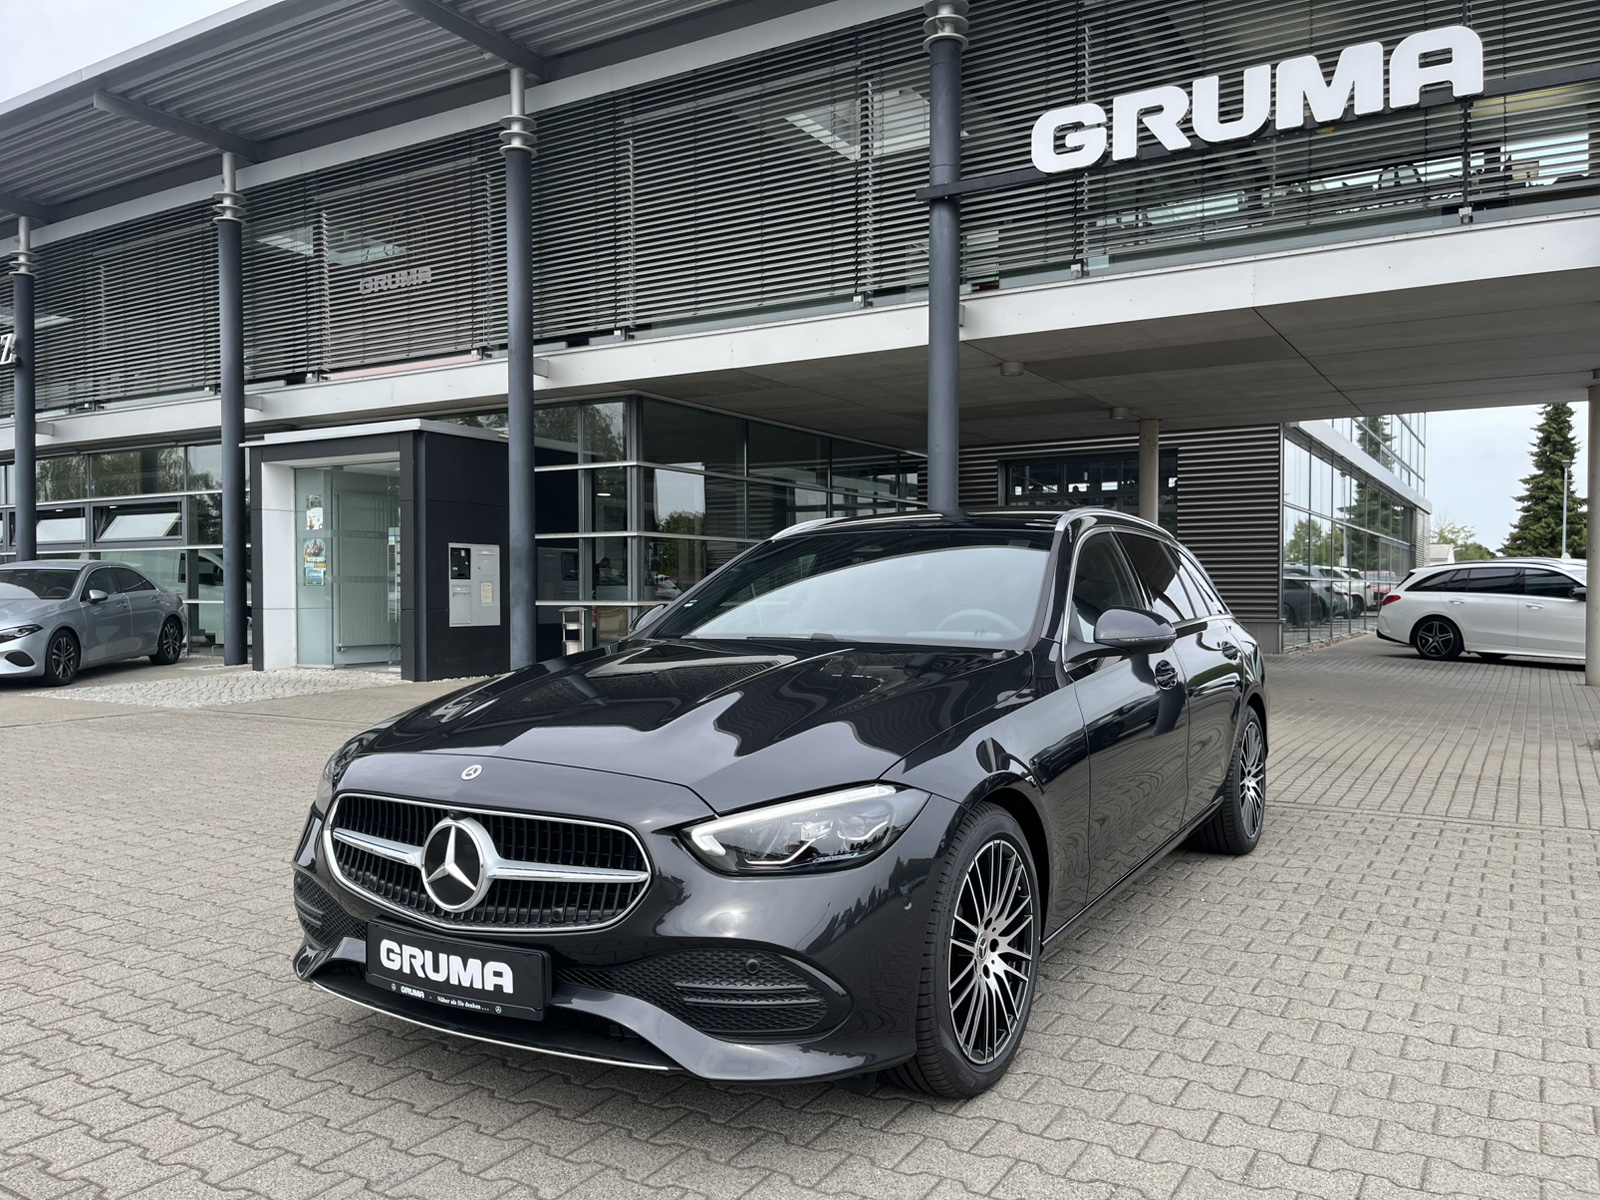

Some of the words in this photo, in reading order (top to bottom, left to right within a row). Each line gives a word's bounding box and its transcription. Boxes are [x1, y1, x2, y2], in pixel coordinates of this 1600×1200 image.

[1031, 25, 1484, 174] GRUMA
[360, 266, 432, 294] GRUMA
[380, 939, 514, 994] GRUMA
[400, 985, 425, 999] GRUMA
